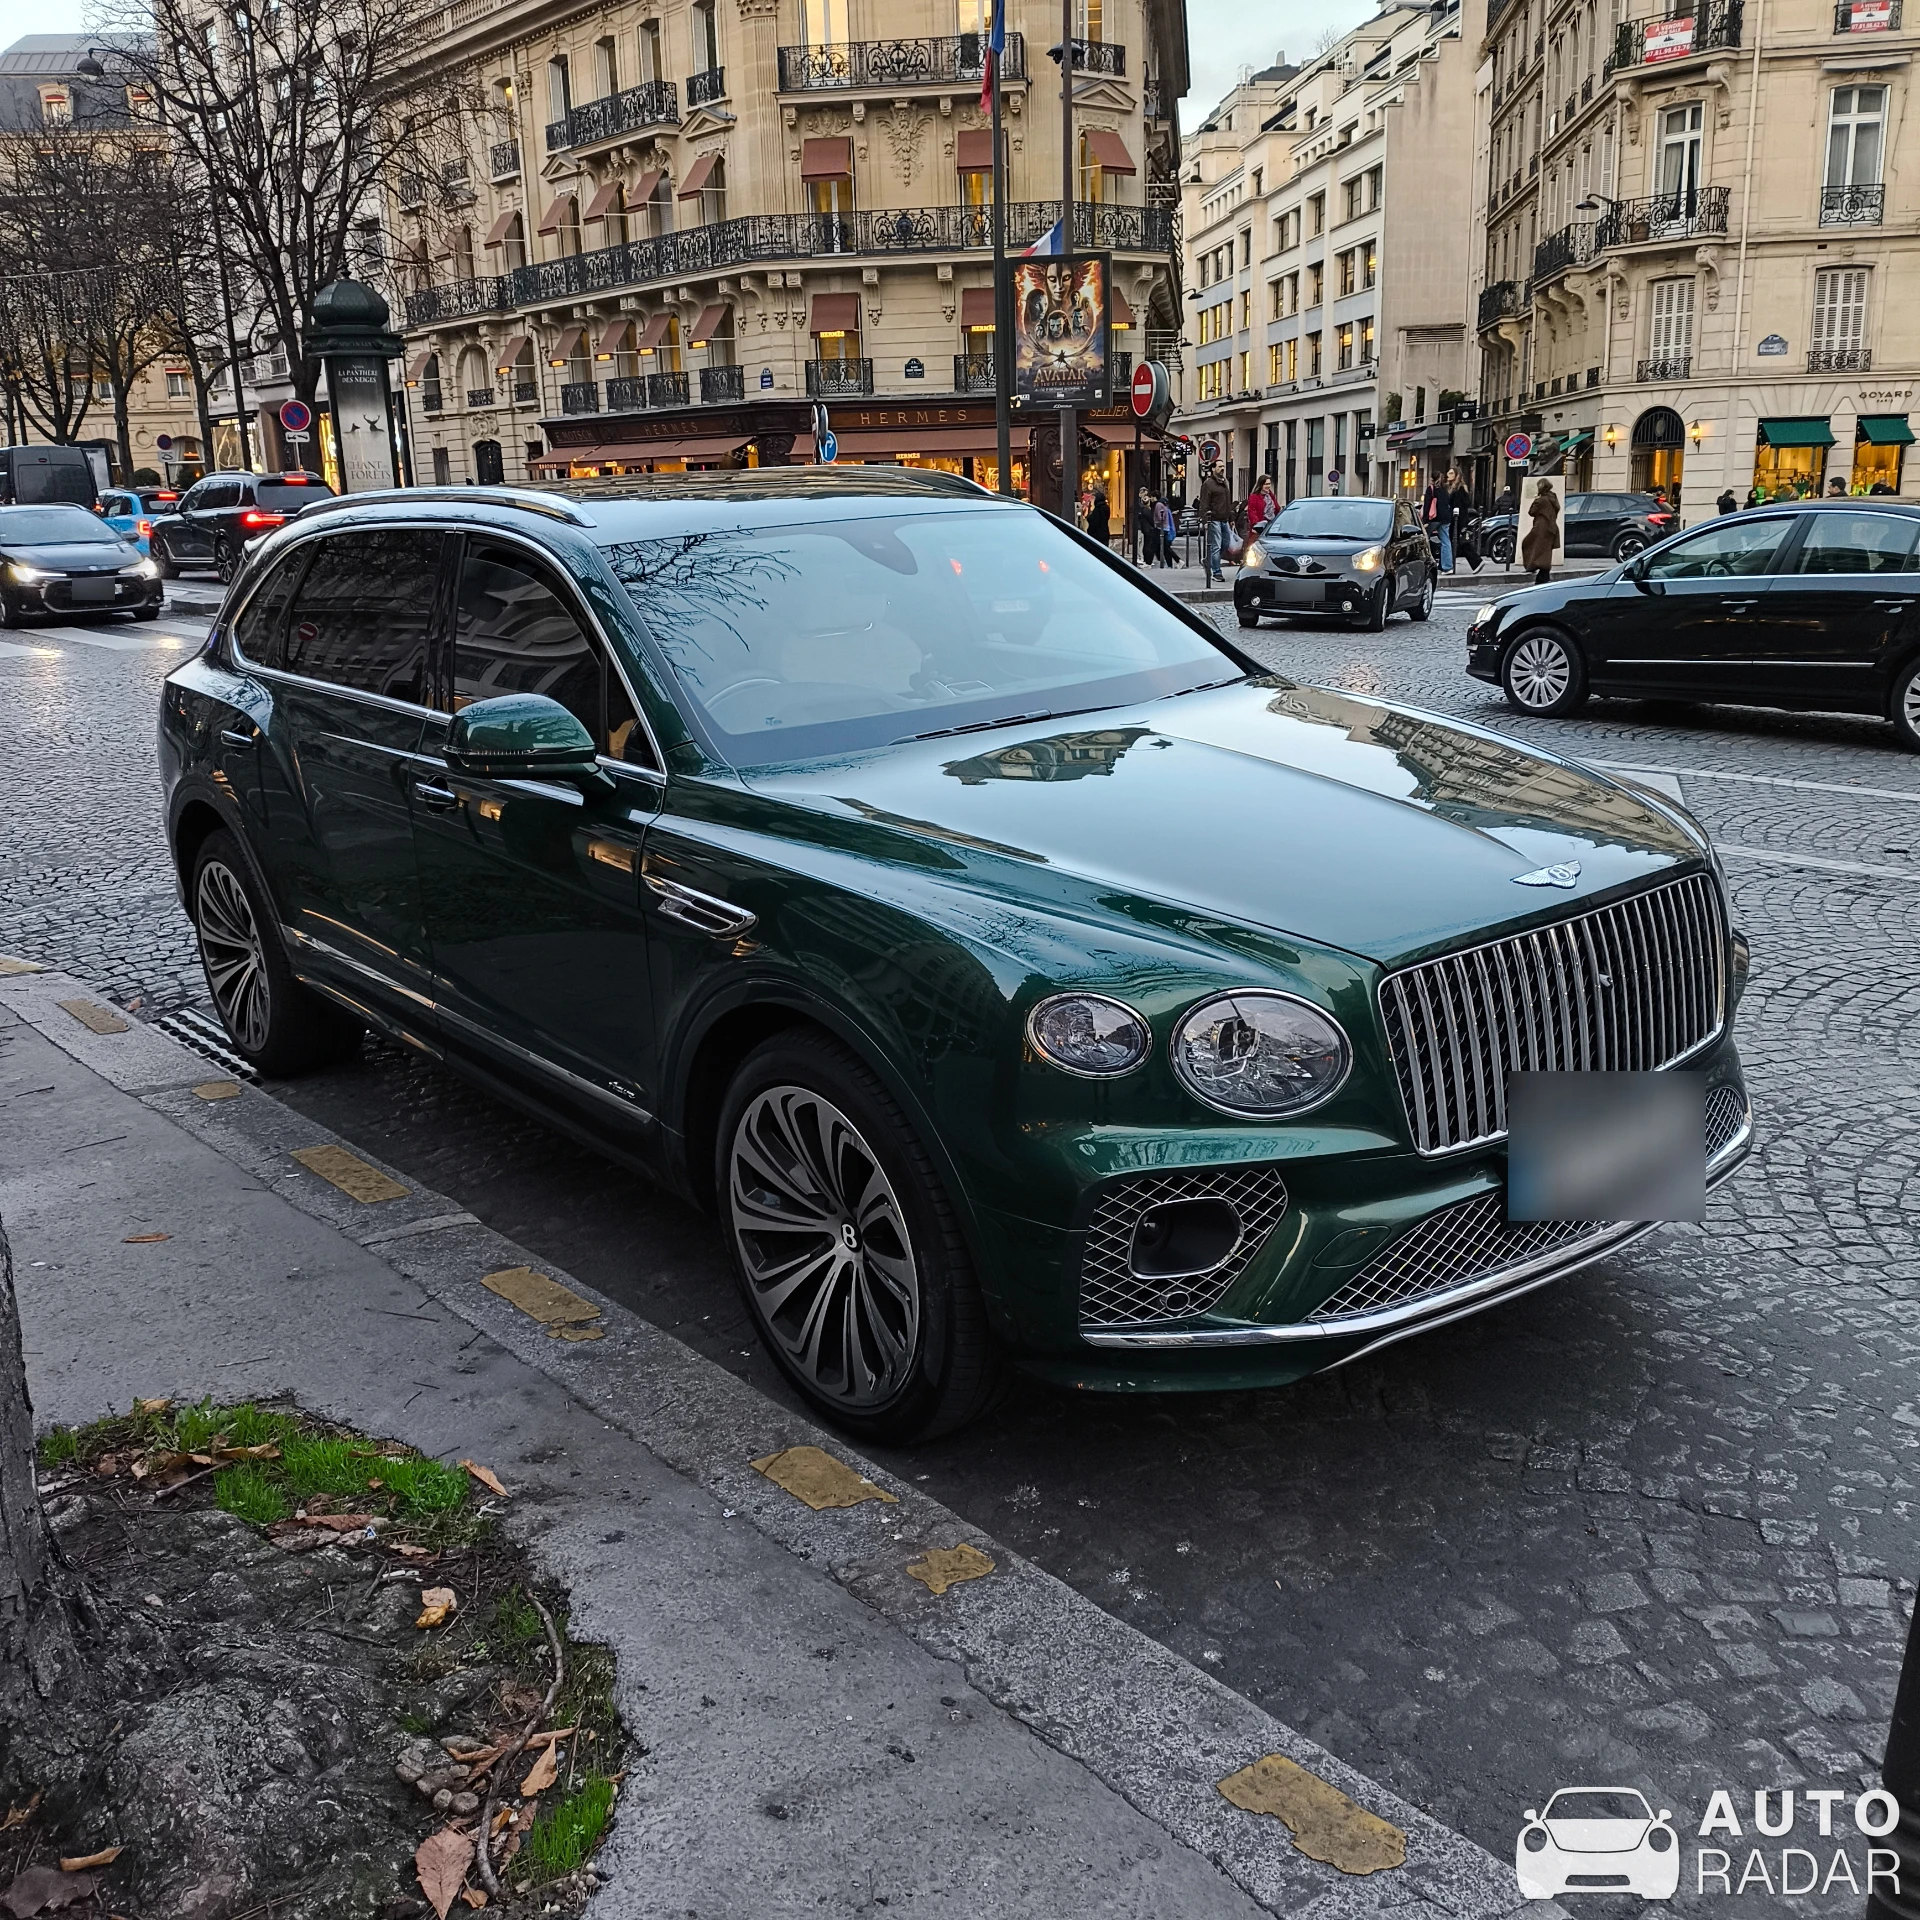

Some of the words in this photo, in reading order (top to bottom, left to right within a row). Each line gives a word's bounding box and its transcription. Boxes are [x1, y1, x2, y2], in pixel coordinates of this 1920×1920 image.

[1661, 21, 1685, 31] VENDRE
[1033, 368, 1088, 383] AVATAR
[1859, 390, 1913, 399] GOYARD
[1089, 405, 1129, 417] SELLIER
[345, 460, 382, 470] CHANT
